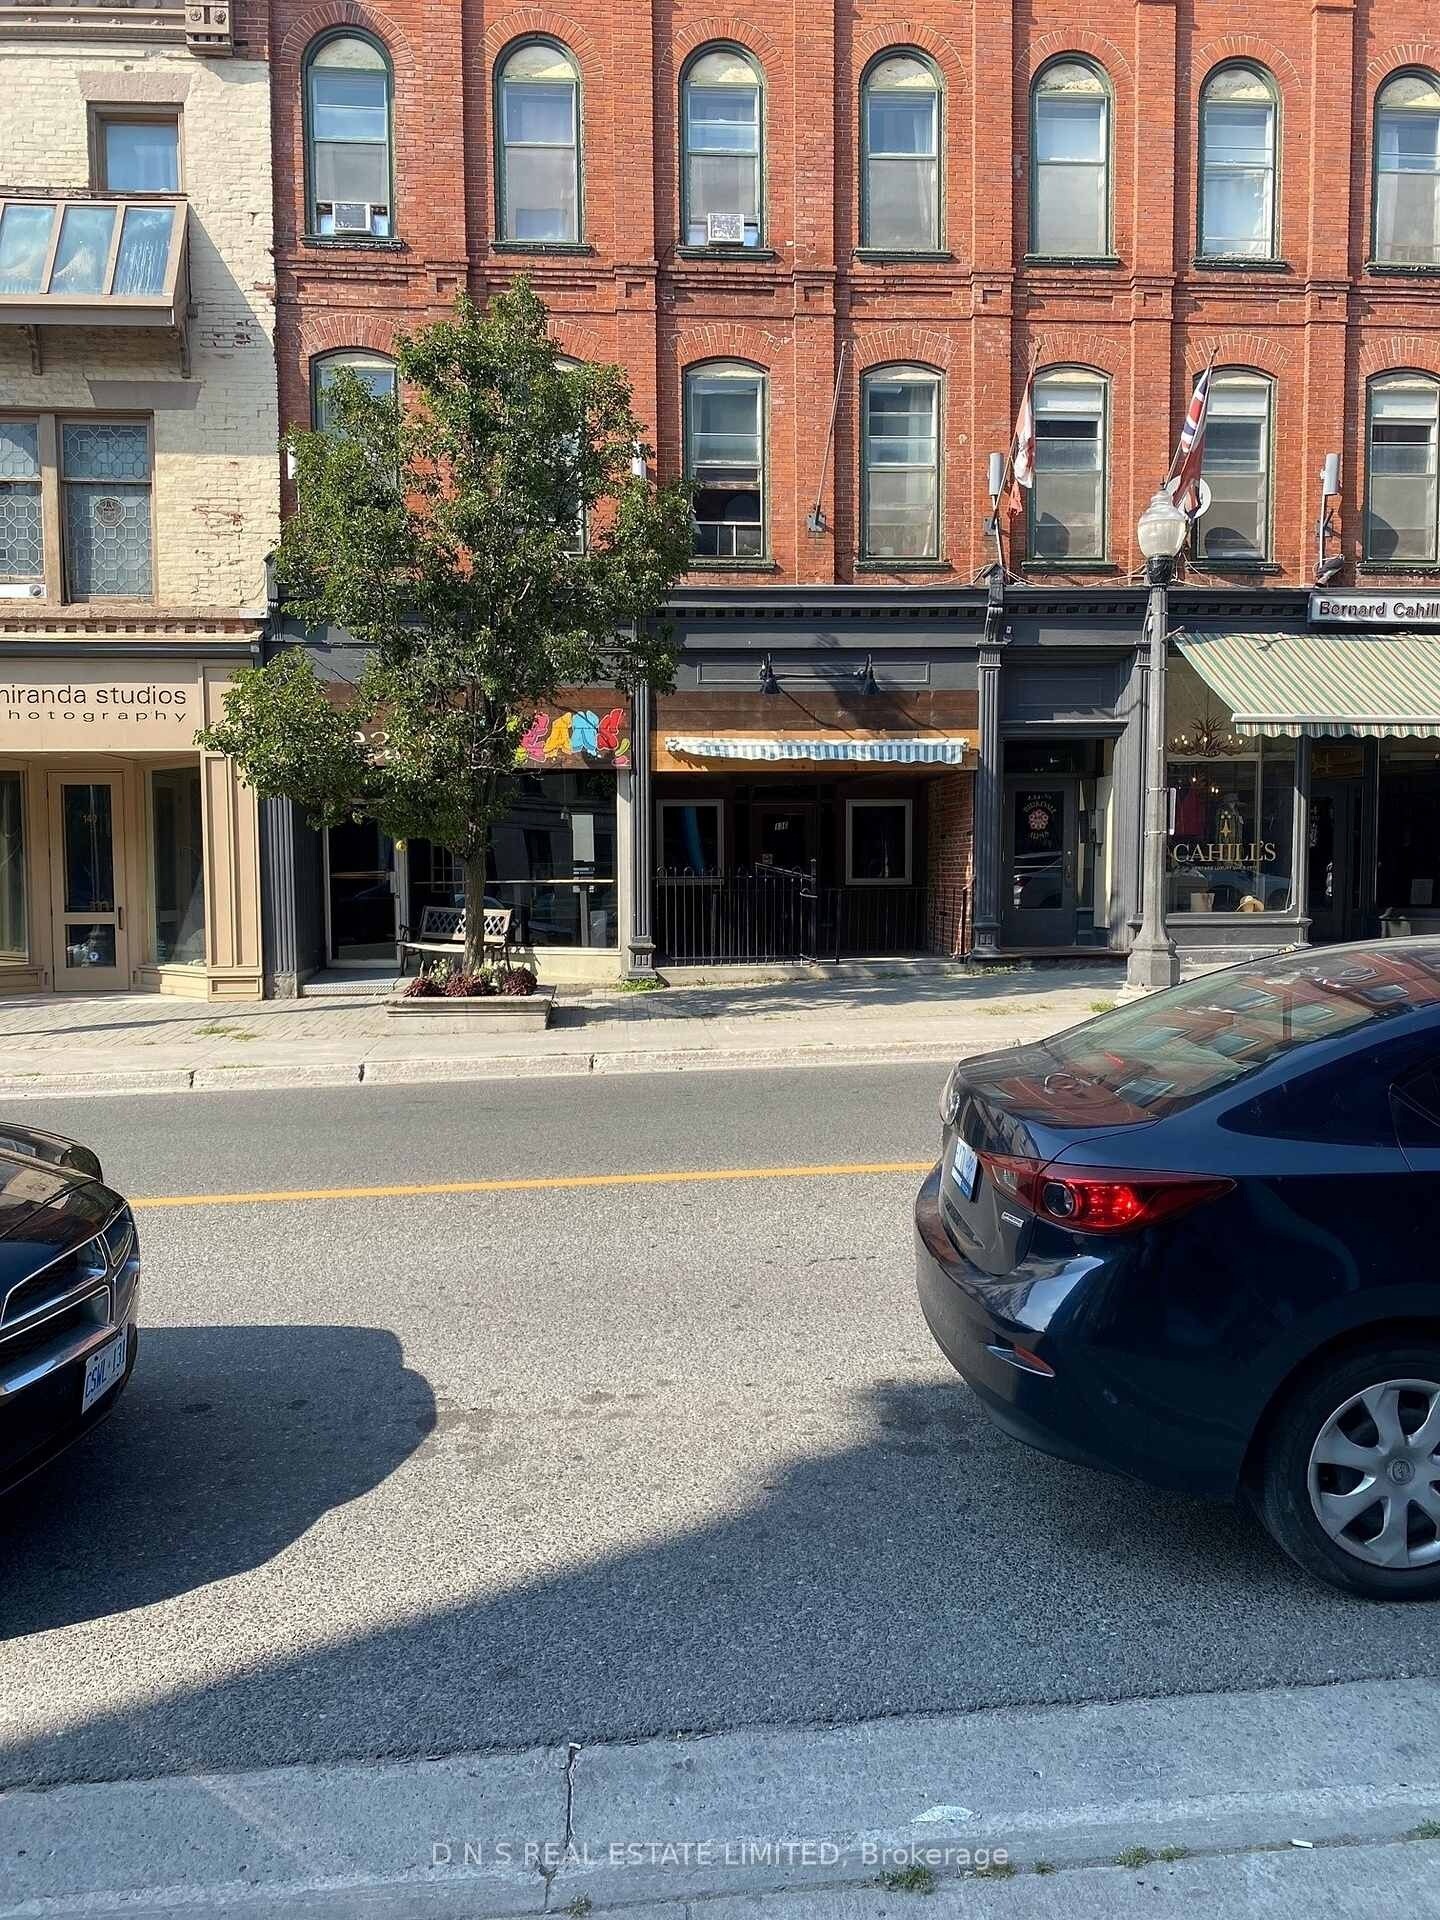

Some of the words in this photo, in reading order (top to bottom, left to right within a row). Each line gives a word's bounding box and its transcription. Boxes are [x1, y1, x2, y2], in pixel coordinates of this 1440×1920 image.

[1320, 601, 1386, 617] Bernard
[1393, 602, 1440, 618] Cahill
[96, 684, 186, 704] studios
[1173, 840, 1277, 862] CAHILL'S
